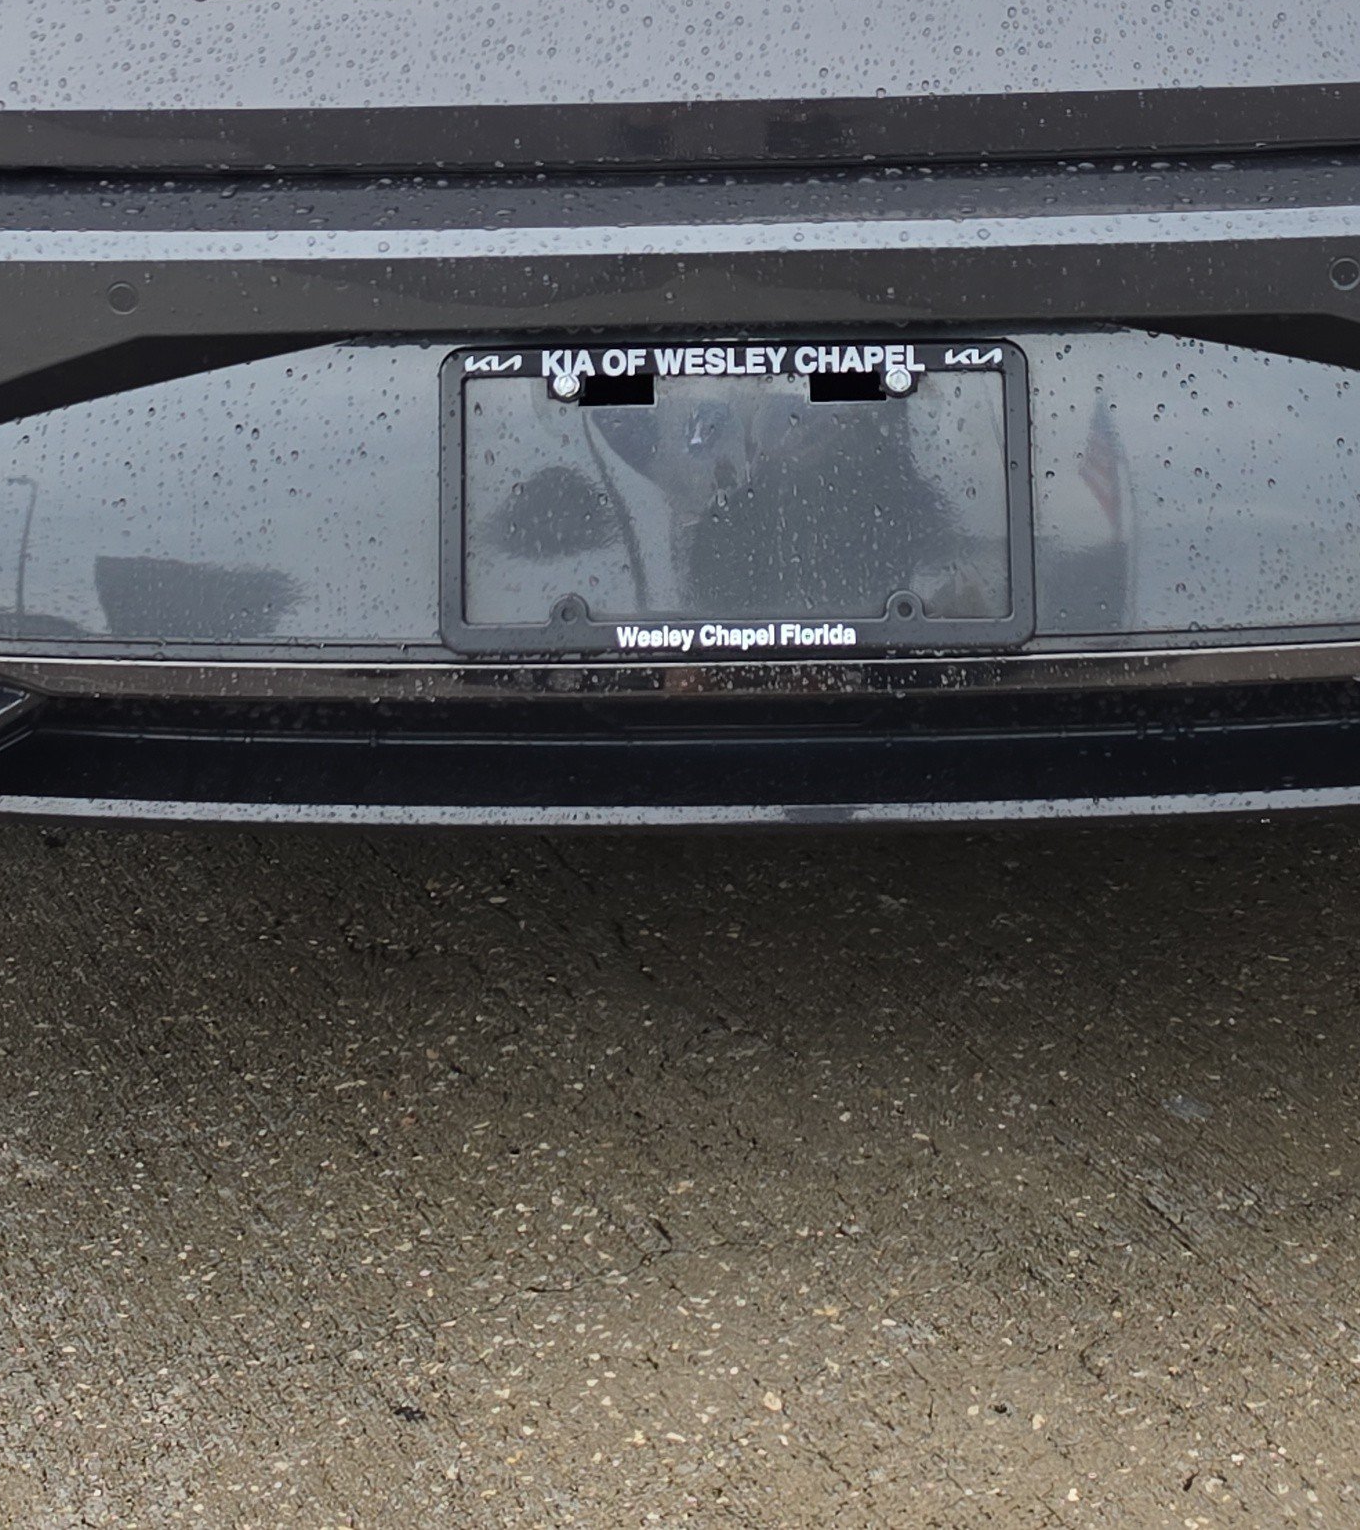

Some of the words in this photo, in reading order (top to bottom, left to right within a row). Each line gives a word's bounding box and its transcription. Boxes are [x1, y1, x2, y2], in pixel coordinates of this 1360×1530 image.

[542, 349, 595, 376] KIA
[602, 349, 646, 376] OF
[656, 346, 787, 375] WESLEY
[794, 345, 925, 374] CHAPEL
[617, 625, 694, 651] Wesley
[700, 624, 775, 650] Chapel
[781, 624, 856, 647] Florida
